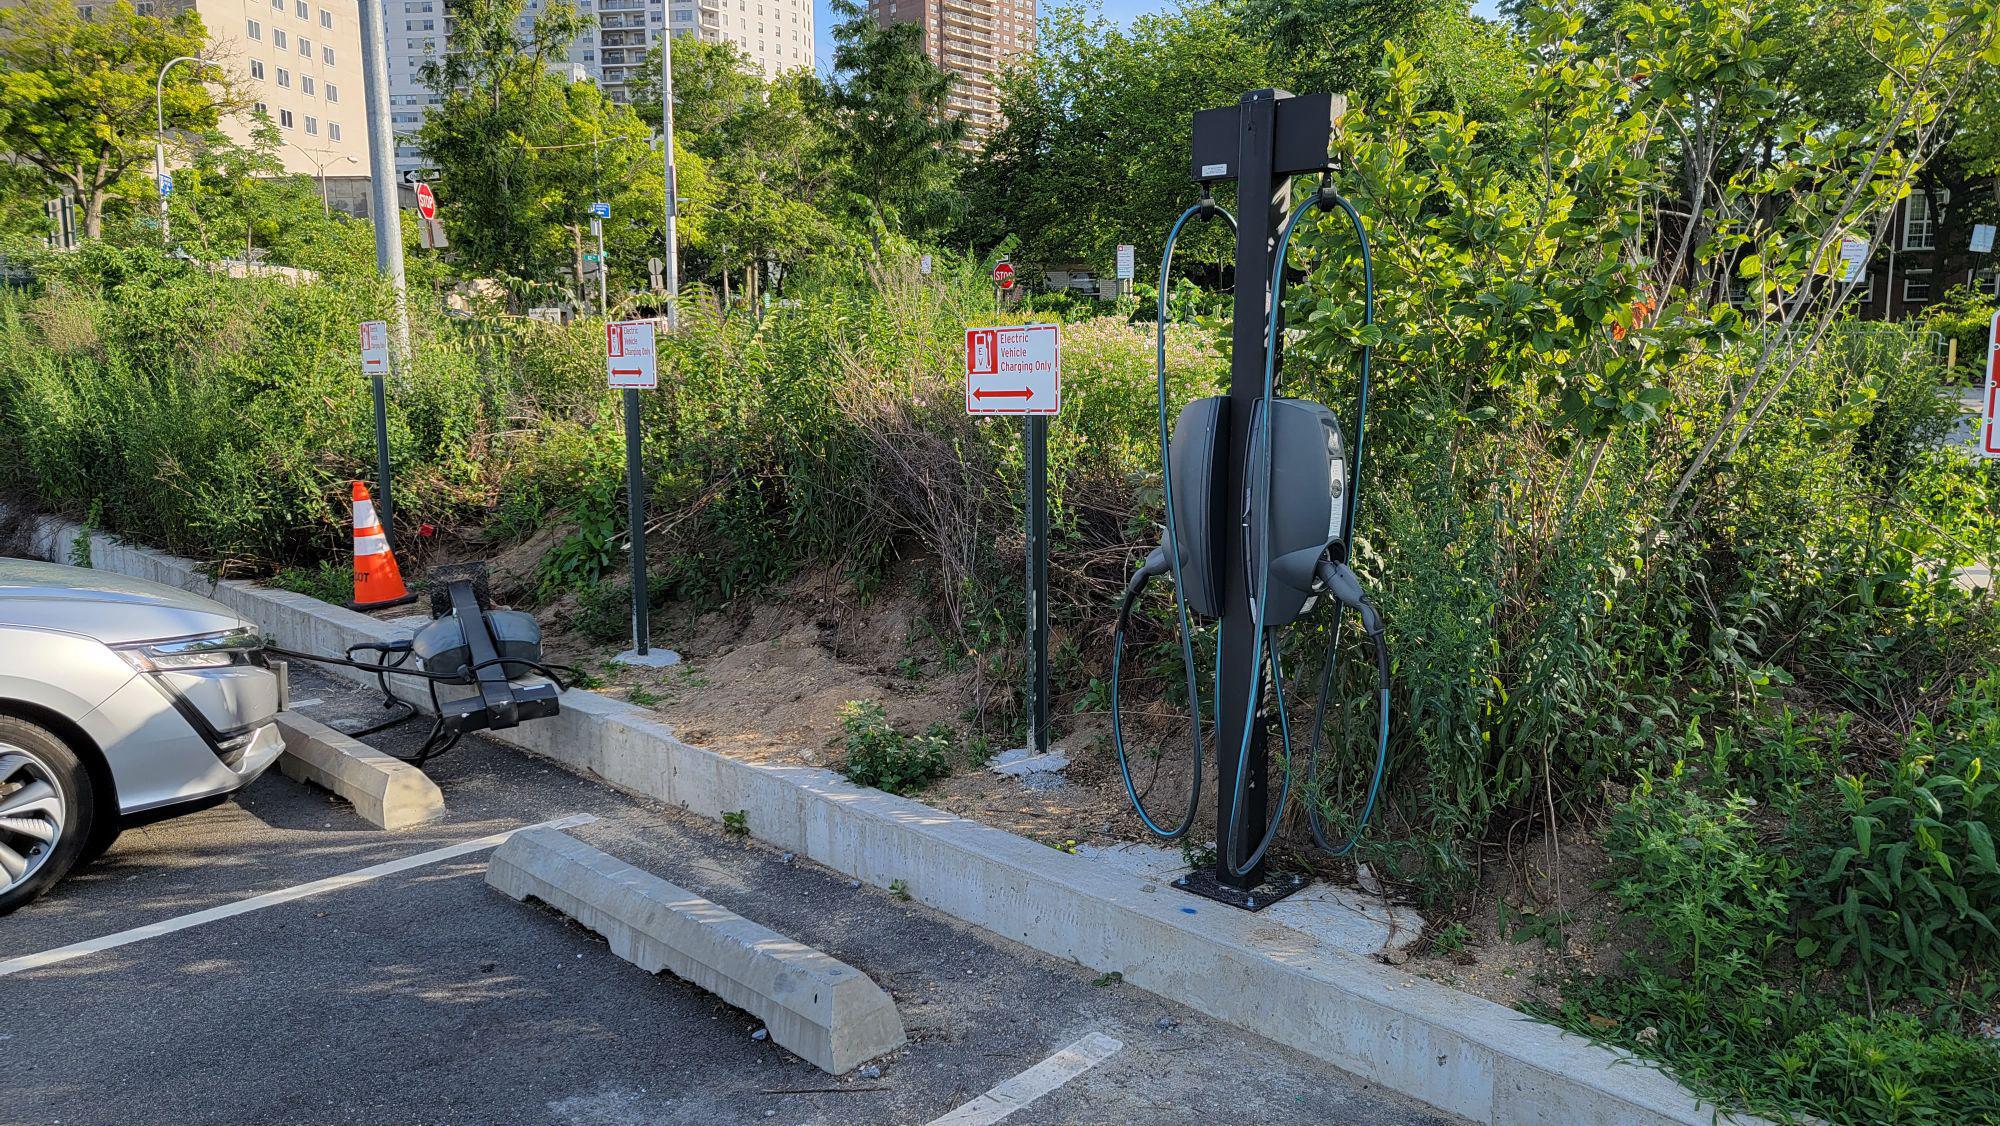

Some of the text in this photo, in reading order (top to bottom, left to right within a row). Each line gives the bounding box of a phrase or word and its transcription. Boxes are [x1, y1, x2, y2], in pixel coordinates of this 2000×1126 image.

[419, 194, 433, 209] STOP
[624, 327, 639, 335] Electric
[624, 337, 638, 345] Vehicle
[1000, 333, 1029, 344] Electric
[625, 347, 651, 357] Charging Only
[1000, 347, 1027, 358] Vehicle
[1000, 360, 1052, 374] Charging Only
